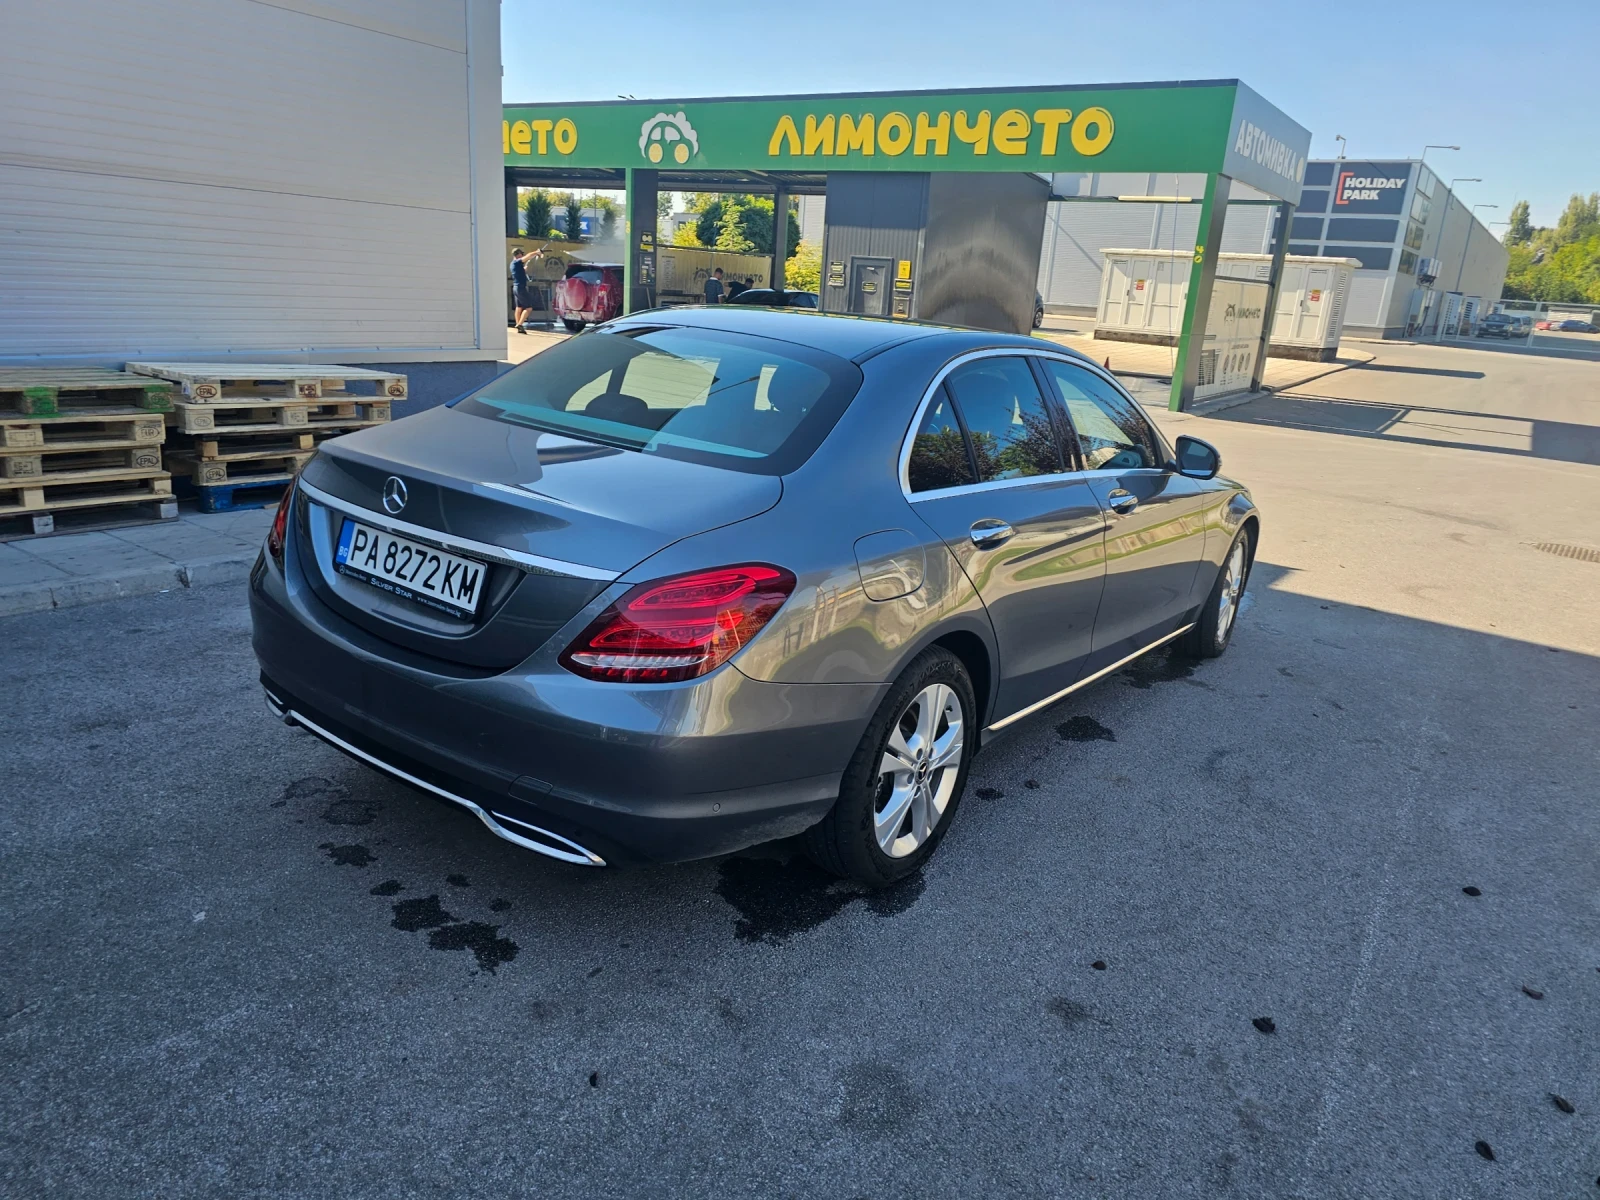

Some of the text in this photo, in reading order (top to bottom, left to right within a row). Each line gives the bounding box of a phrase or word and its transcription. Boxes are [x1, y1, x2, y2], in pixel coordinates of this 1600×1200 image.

[1234, 119, 1297, 182] АВТОМИВКА
[1344, 177, 1406, 189] HOLIDAY
[1342, 189, 1380, 200] PARK
[198, 387, 214, 396] EPAL
[139, 457, 154, 465] EPAL
[207, 469, 223, 478] EPAL
[338, 546, 349, 557] BG
[395, 586, 413, 600] STAR
